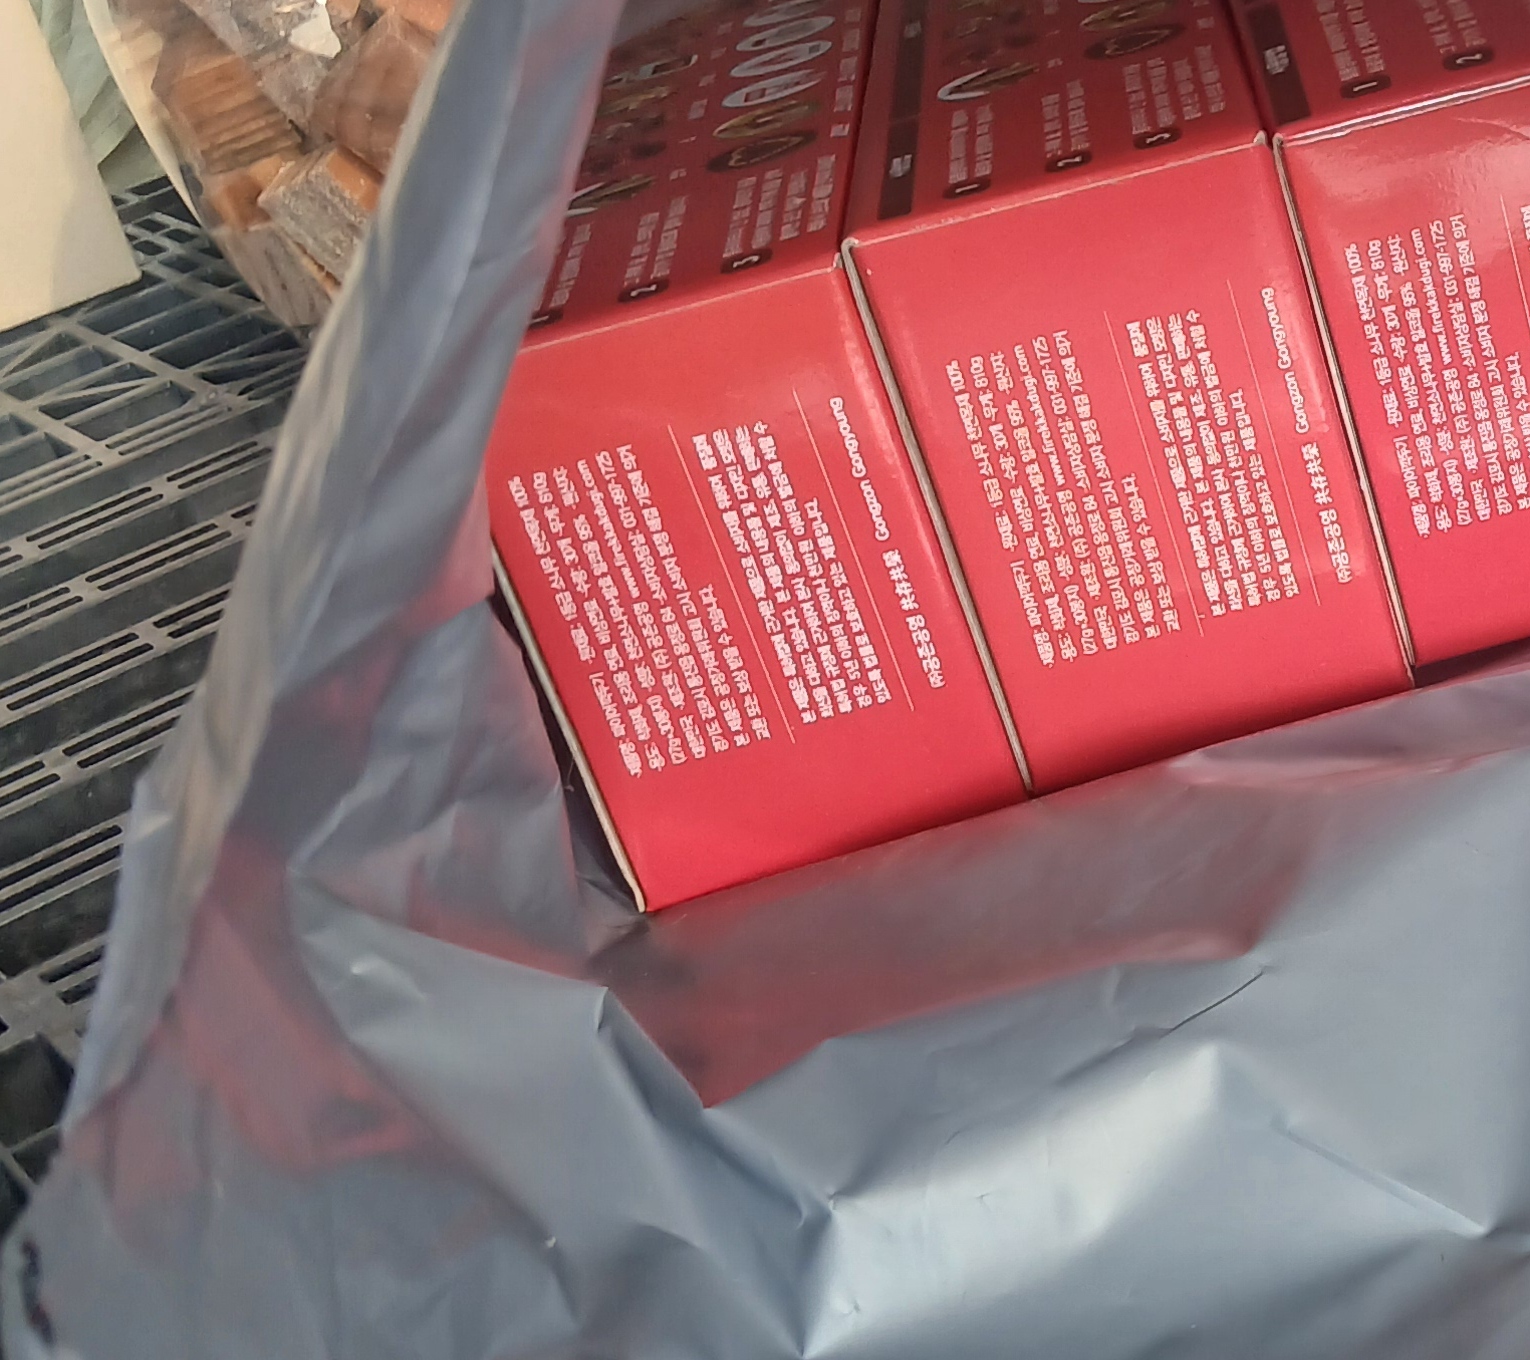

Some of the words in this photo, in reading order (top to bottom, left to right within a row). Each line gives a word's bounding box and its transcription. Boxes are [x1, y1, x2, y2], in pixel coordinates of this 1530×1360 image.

[1448, 213, 1467, 239] 의거
[1343, 242, 1364, 275] 100%
[1366, 238, 1385, 271] 810g
[1427, 219, 1459, 296] 031-997-1725
[1454, 238, 1476, 276] 기준에
[1350, 273, 1376, 322] 천연목재
[1462, 273, 1482, 300] 해결
[1379, 303, 1401, 332] 30개
[1468, 298, 1489, 325] 분쟁
[1362, 320, 1385, 356] 소나무
[1474, 323, 1496, 358] 소비자
[1371, 355, 1393, 386] 1등급
[1396, 362, 1420, 410] 비상연료
[1465, 371, 1481, 389] 84
[1482, 357, 1502, 384] 고시
[1440, 366, 1467, 415] 공존공영
[1514, 397, 1530, 412] 수
[1488, 382, 1521, 462] 공정거래위원회
[1392, 434, 1421, 500] 파이어깍두기
[1414, 433, 1436, 469] 조리용
[1482, 450, 1506, 485] 김포시
[1507, 460, 1528, 496] 제품은
[1468, 477, 1492, 521] 대한민국
[1491, 481, 1513, 516] 경기도
